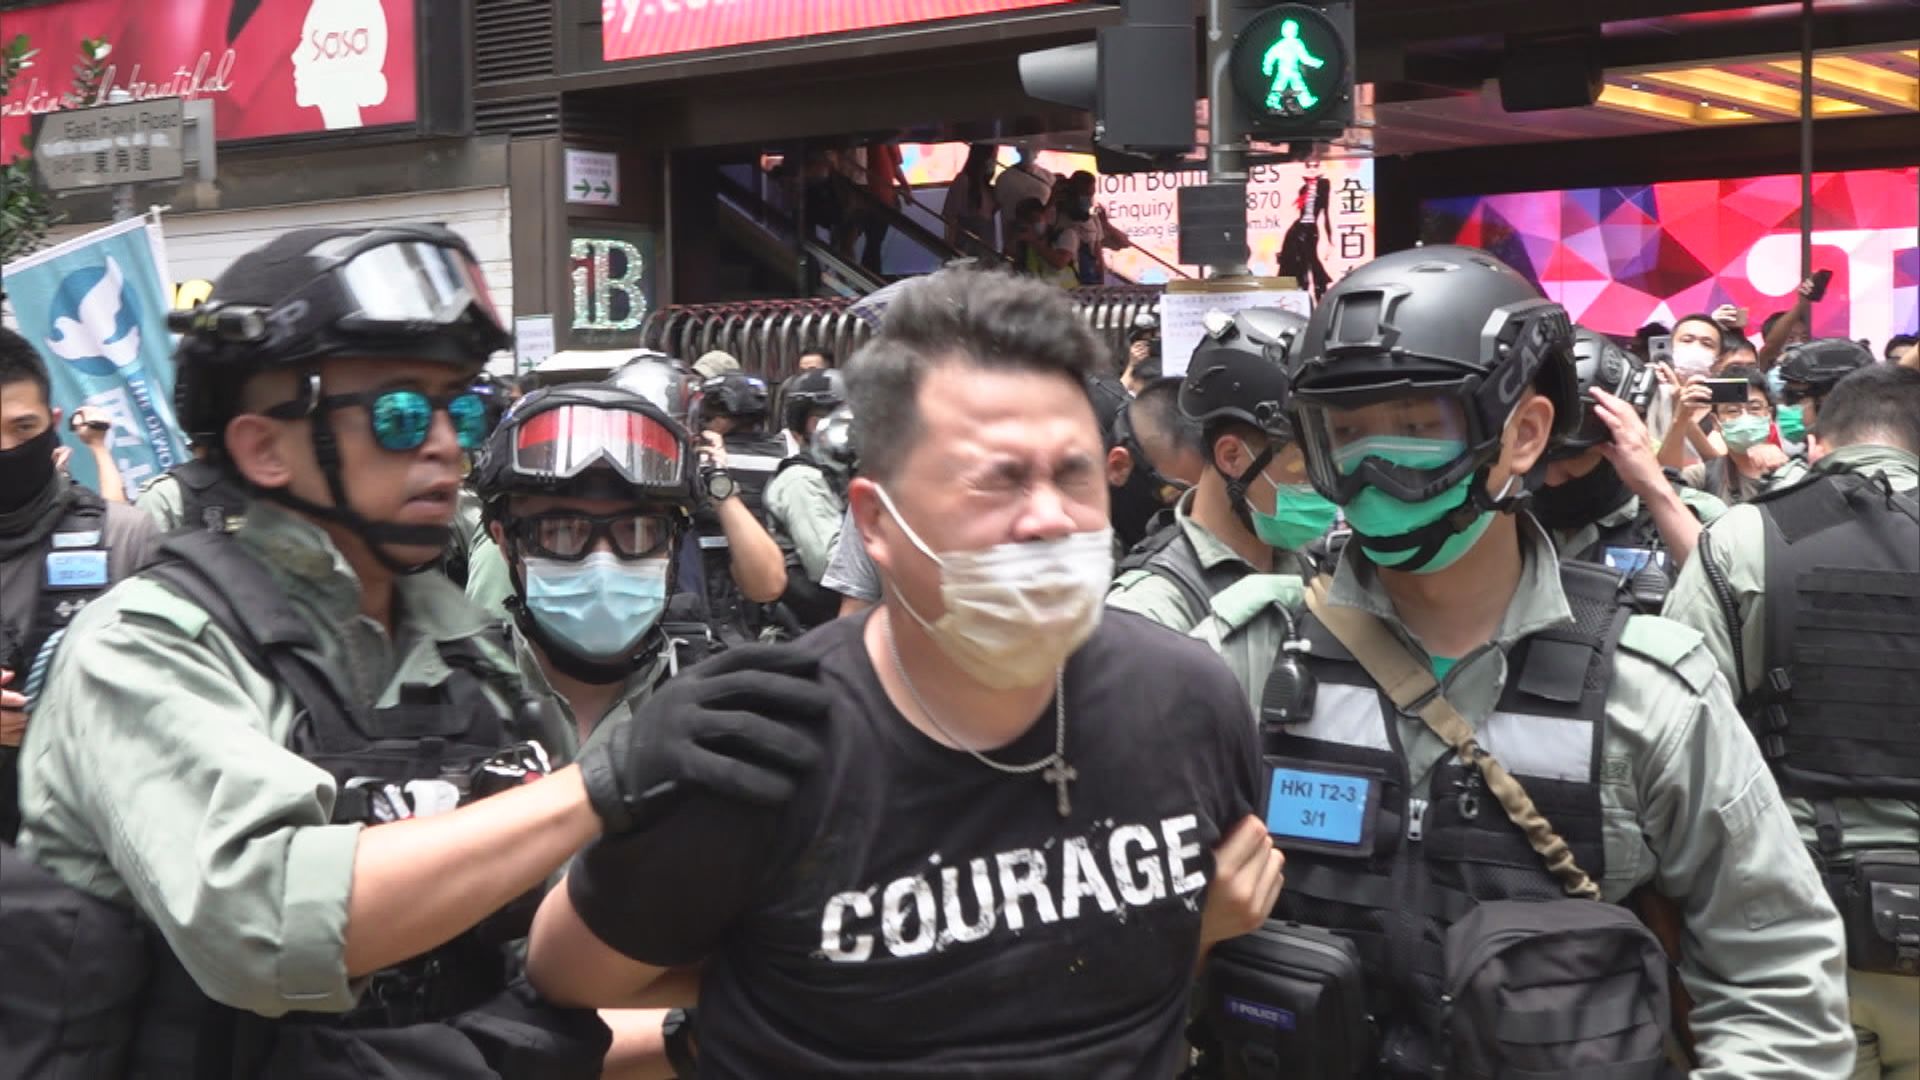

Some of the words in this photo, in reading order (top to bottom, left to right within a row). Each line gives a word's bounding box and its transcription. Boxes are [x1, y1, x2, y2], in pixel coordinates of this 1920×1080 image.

[63, 120, 98, 139] East
[101, 115, 137, 135] Point
[140, 111, 179, 130] Road
[1108, 199, 1174, 221] Enquiry
[1335, 177, 1370, 273] 金百
[1280, 779, 1313, 798] HKI
[1319, 783, 1357, 803] T2-3
[1301, 809, 1326, 828] 3/1
[821, 814, 1207, 963] COURAGE
